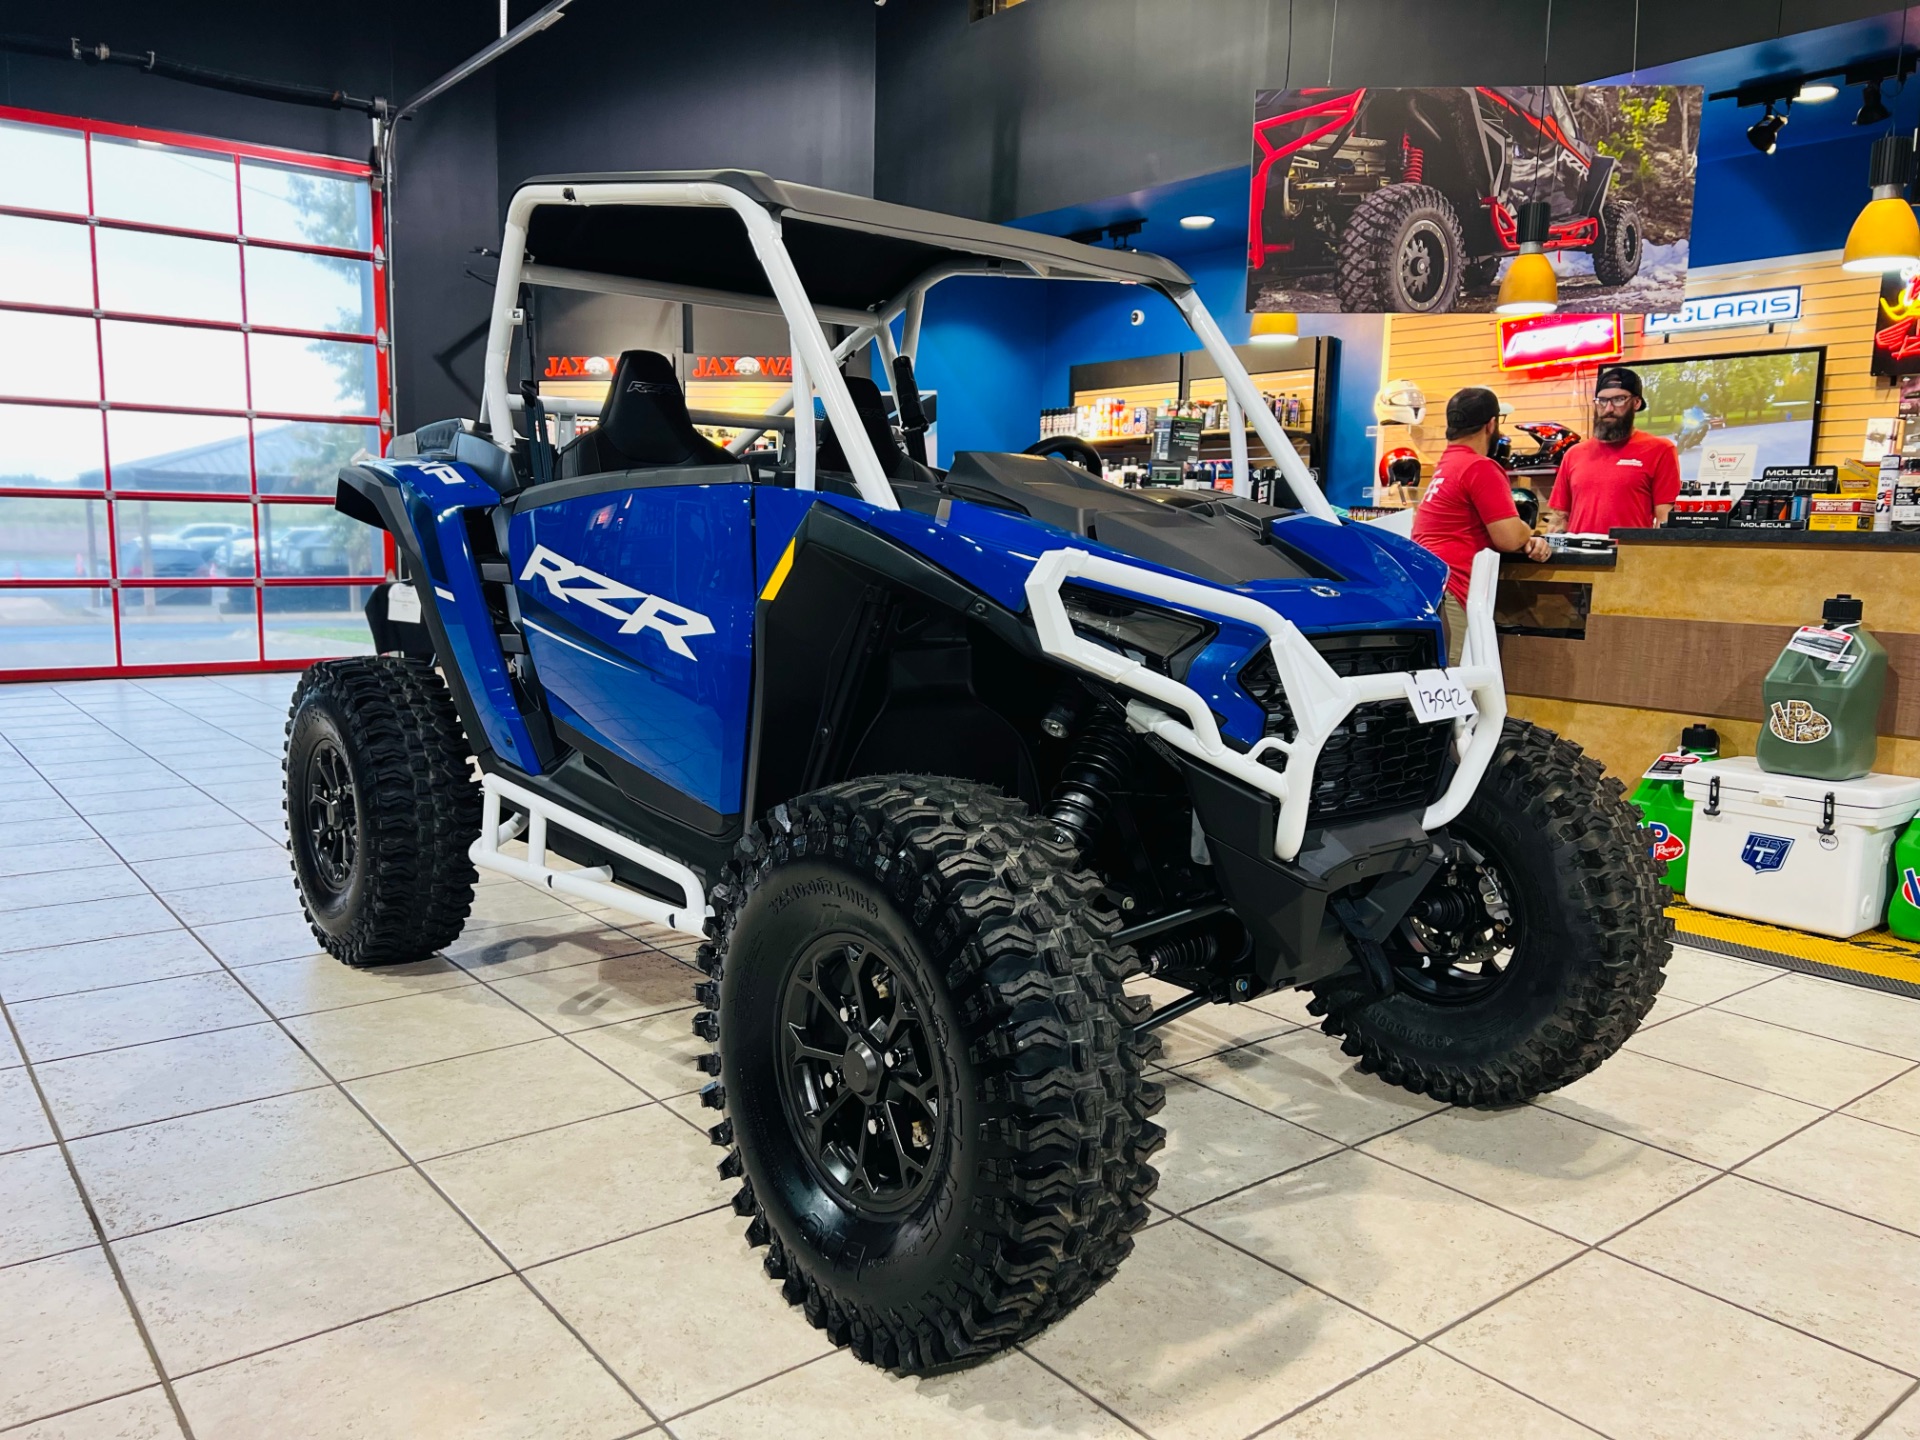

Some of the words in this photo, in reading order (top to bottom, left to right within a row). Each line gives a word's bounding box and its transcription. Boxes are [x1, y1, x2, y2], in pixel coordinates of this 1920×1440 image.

[1558, 148, 1589, 181] RZR
[693, 356, 736, 378] JAX
[759, 356, 793, 376] WA
[411, 461, 466, 485] XP
[1766, 468, 1834, 476] MOLECULE
[519, 544, 716, 661] RZR
[1419, 687, 1466, 713] 13542
[1770, 700, 1814, 742] VP
[1656, 844, 1684, 857] Racing
